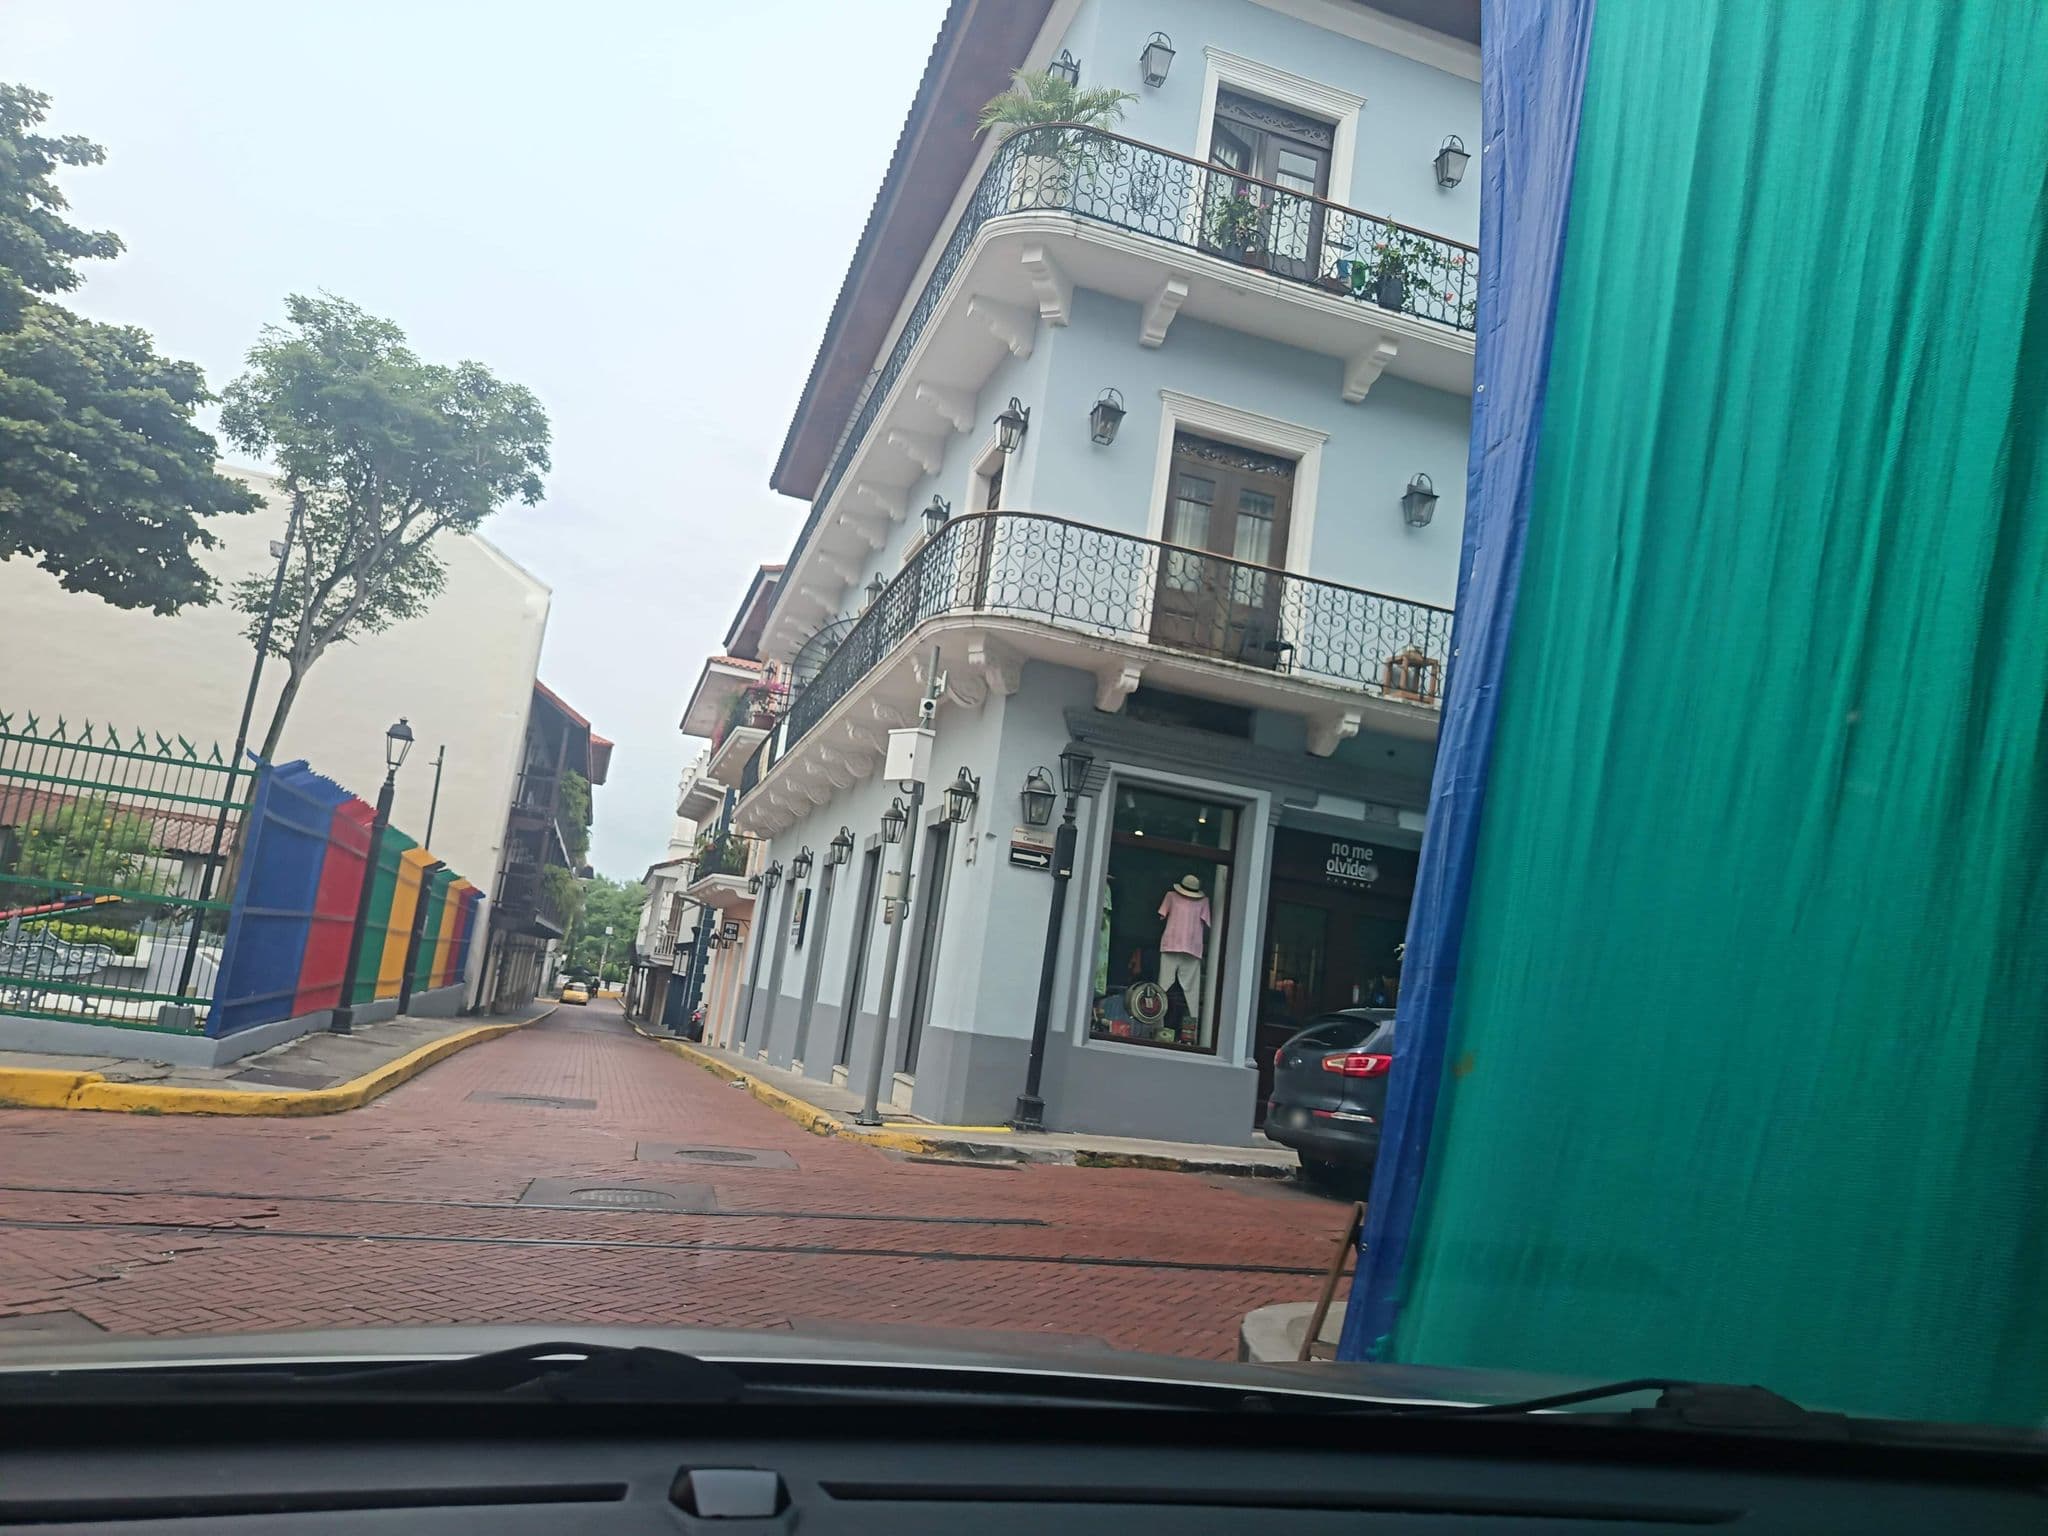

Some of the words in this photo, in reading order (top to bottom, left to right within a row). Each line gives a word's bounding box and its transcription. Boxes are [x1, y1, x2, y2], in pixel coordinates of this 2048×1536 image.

[1331, 842, 1349, 856] no
[1352, 846, 1374, 861] me
[1326, 856, 1378, 879] olvide
